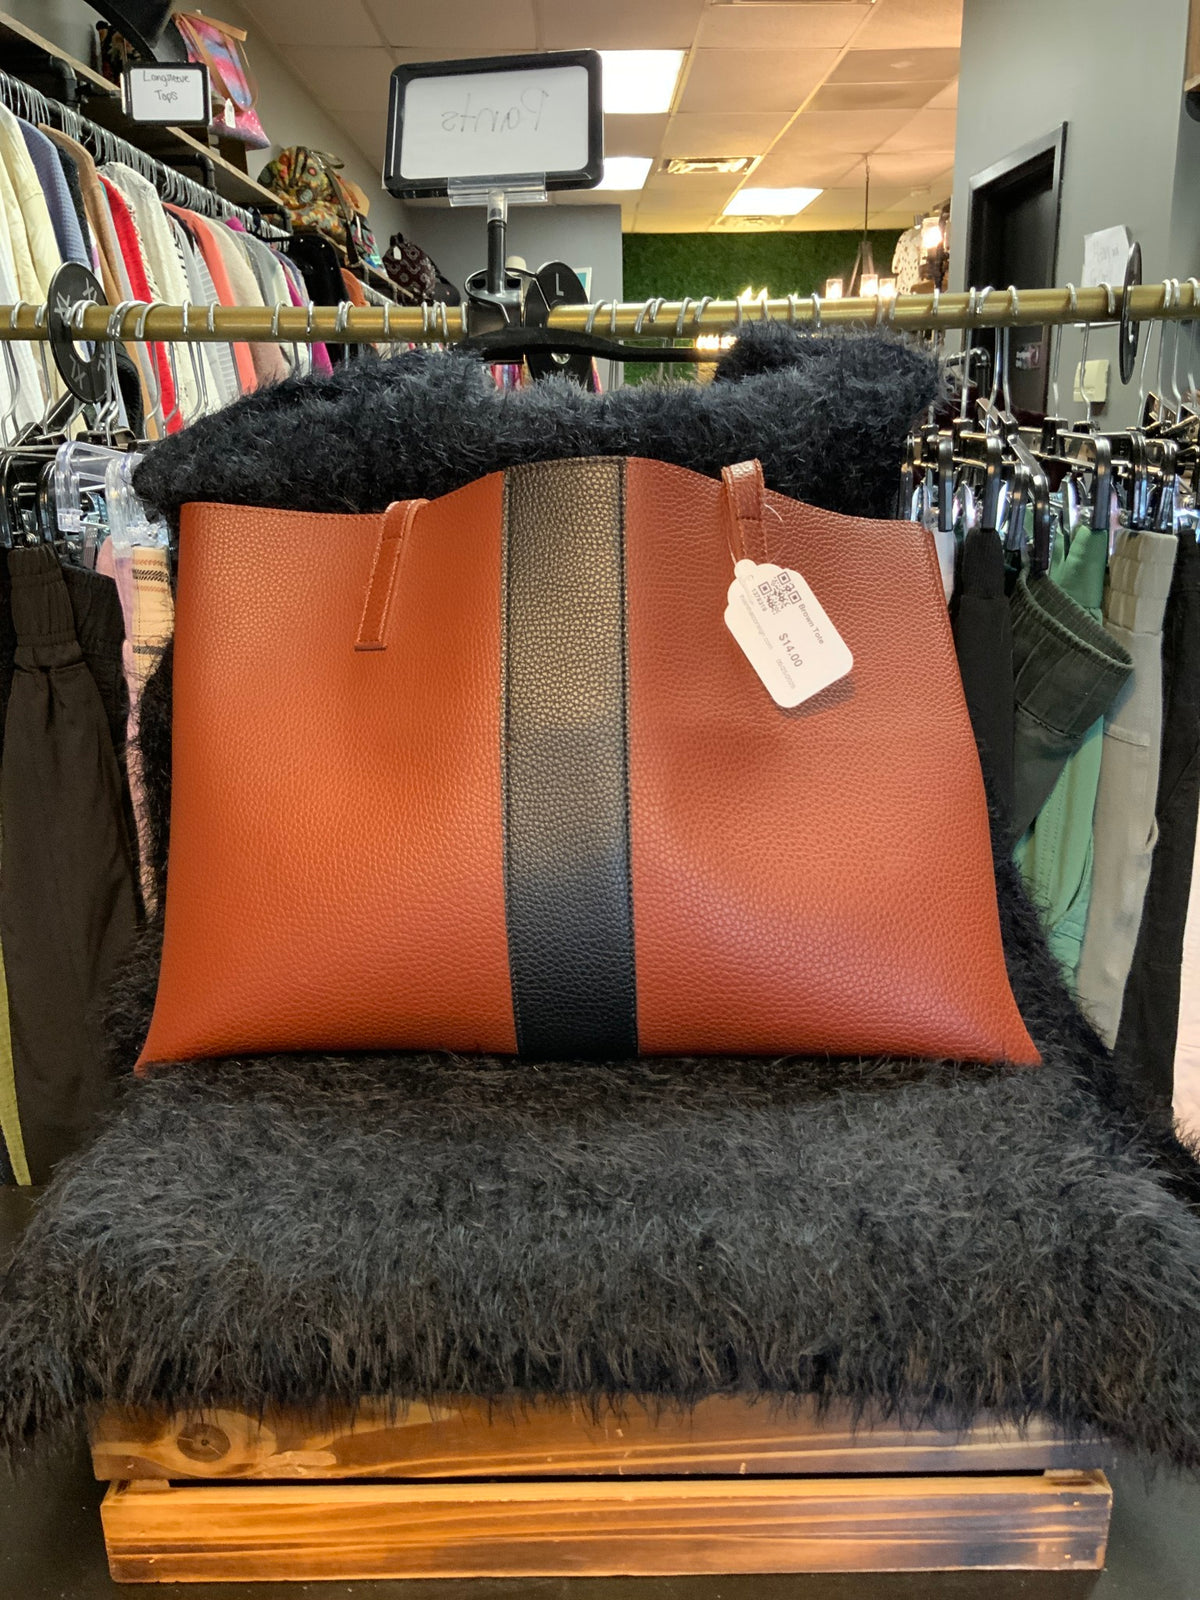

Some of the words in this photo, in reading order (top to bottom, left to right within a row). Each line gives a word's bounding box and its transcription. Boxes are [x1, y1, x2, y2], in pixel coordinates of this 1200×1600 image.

[154, 89, 179, 103] Tops
[555, 272, 565, 297] L
[798, 603, 814, 628] Brown
[813, 626, 825, 645] Tote
[778, 632, 803, 668] $14.00
